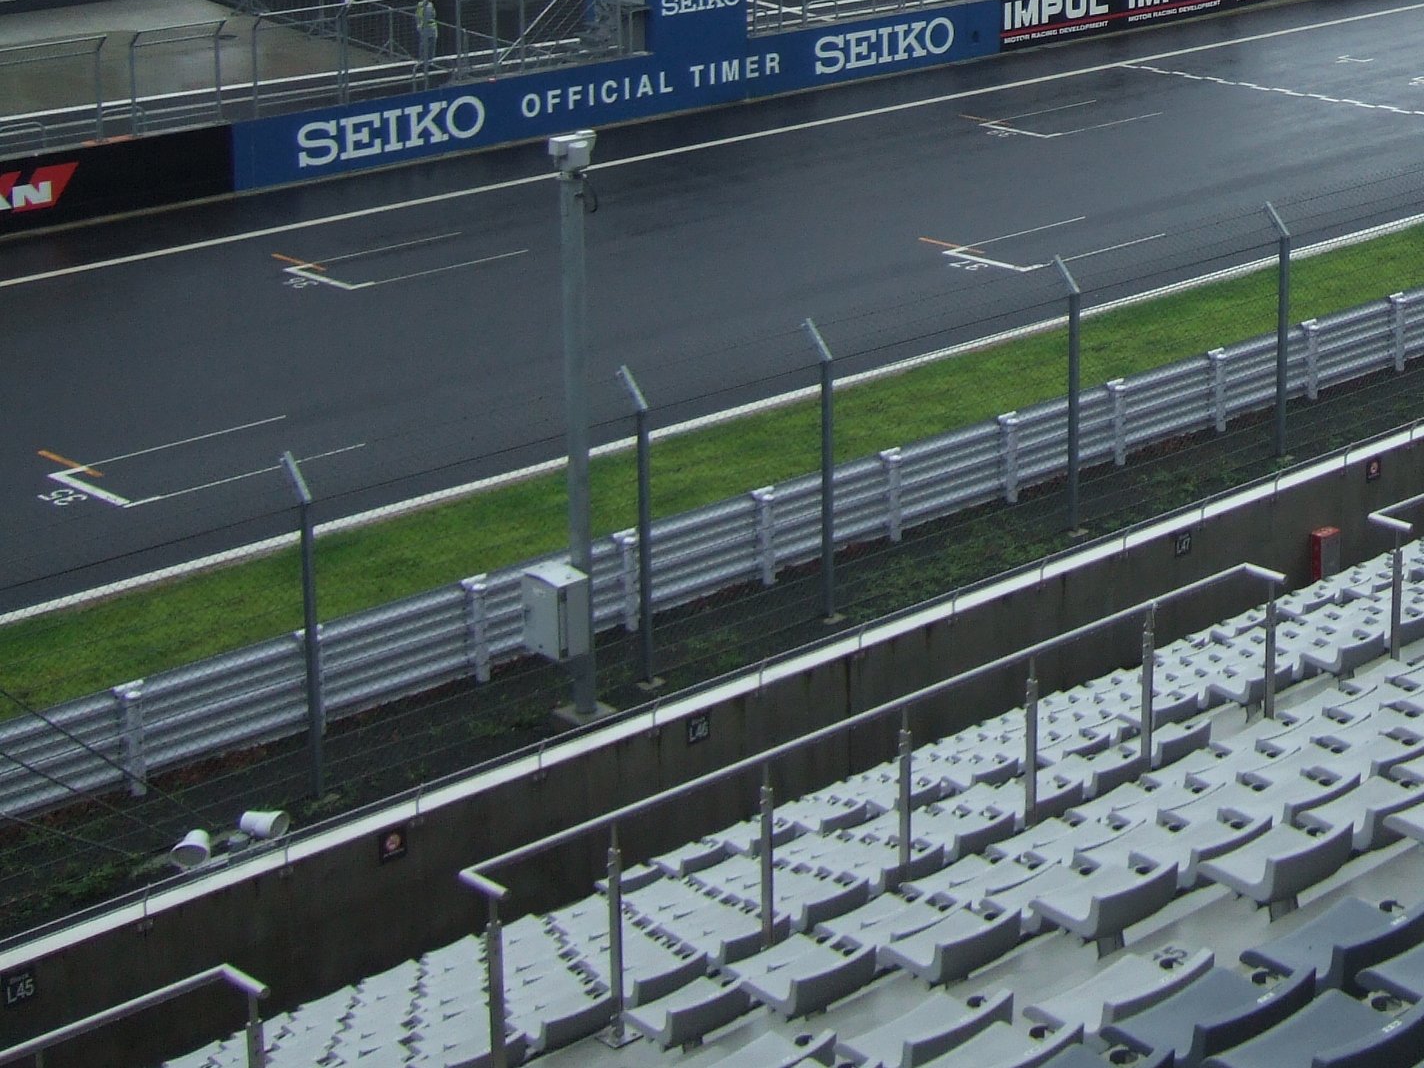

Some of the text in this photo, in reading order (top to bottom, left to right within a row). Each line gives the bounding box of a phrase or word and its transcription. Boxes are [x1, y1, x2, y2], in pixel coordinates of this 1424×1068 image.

[814, 17, 955, 75] SEIKO
[521, 52, 782, 119] OFFICIAL TIMER
[297, 95, 486, 168] SEIKO
[7, 978, 34, 1005] L45
